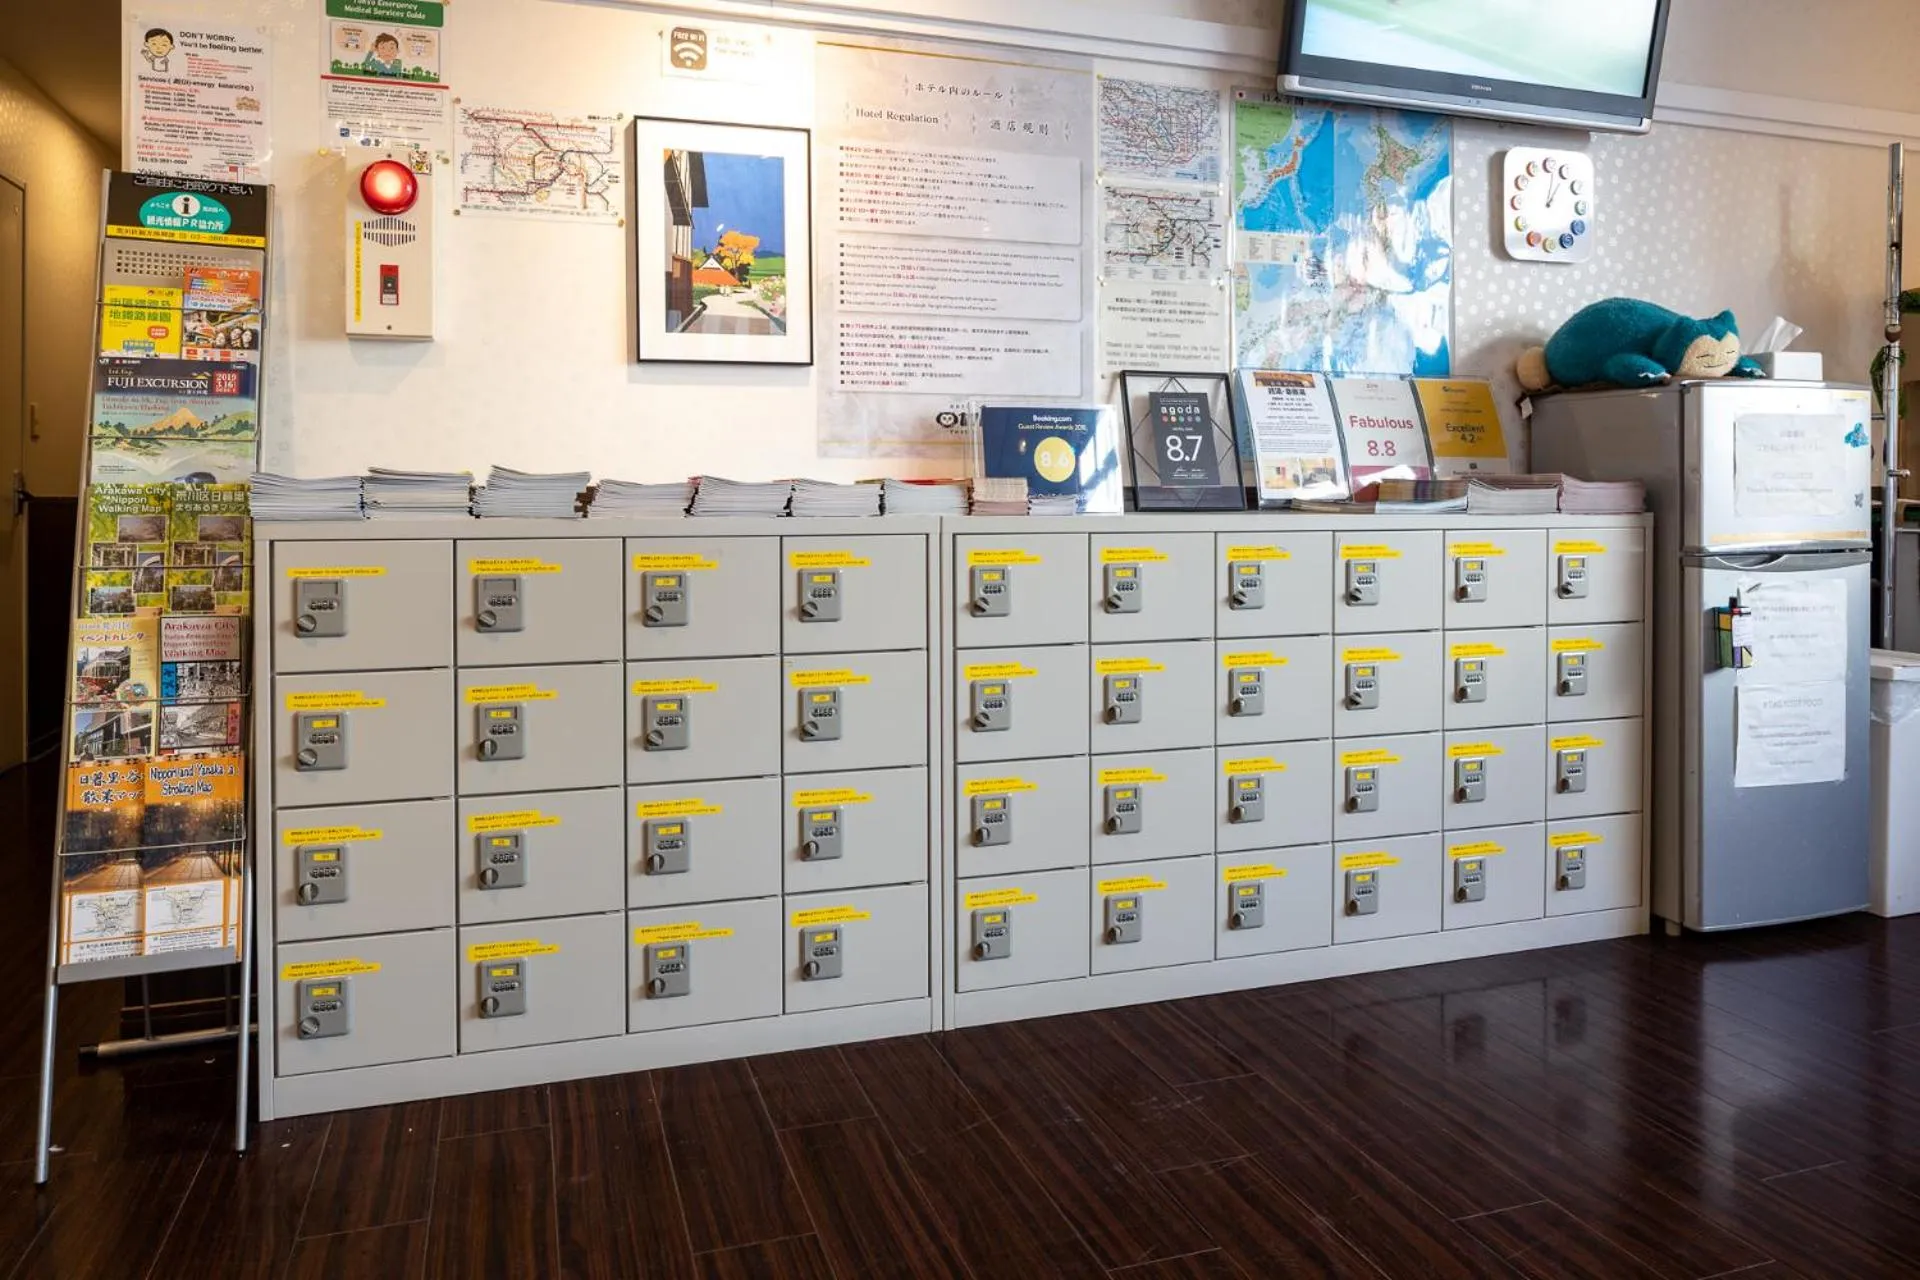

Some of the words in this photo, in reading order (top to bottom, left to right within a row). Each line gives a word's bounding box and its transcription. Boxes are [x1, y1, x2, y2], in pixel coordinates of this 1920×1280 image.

[180, 31, 204, 39] DON'T
[205, 33, 236, 42] WORRY.
[209, 43, 237, 53] feeling
[238, 46, 264, 55] better.
[915, 82, 1004, 99] ホテル内のルール
[856, 108, 882, 119] Hotel
[886, 111, 939, 124] Regulation
[108, 376, 134, 388] FUJI
[136, 378, 208, 391] EXCURSION
[1161, 404, 1201, 416] agoda
[1033, 414, 1072, 423] Booking.com
[1350, 415, 1414, 430] Fabulous
[1445, 423, 1485, 433] Excellent
[1165, 434, 1203, 462] 8.7
[1367, 440, 1397, 457] 8.8
[1041, 451, 1069, 468] 8.6
[95, 486, 141, 495] Arakawa
[145, 486, 166, 496] City
[99, 504, 138, 514] Walking
[142, 504, 161, 515] Map
[165, 622, 211, 631] Arakawa
[179, 766, 194, 777] and
